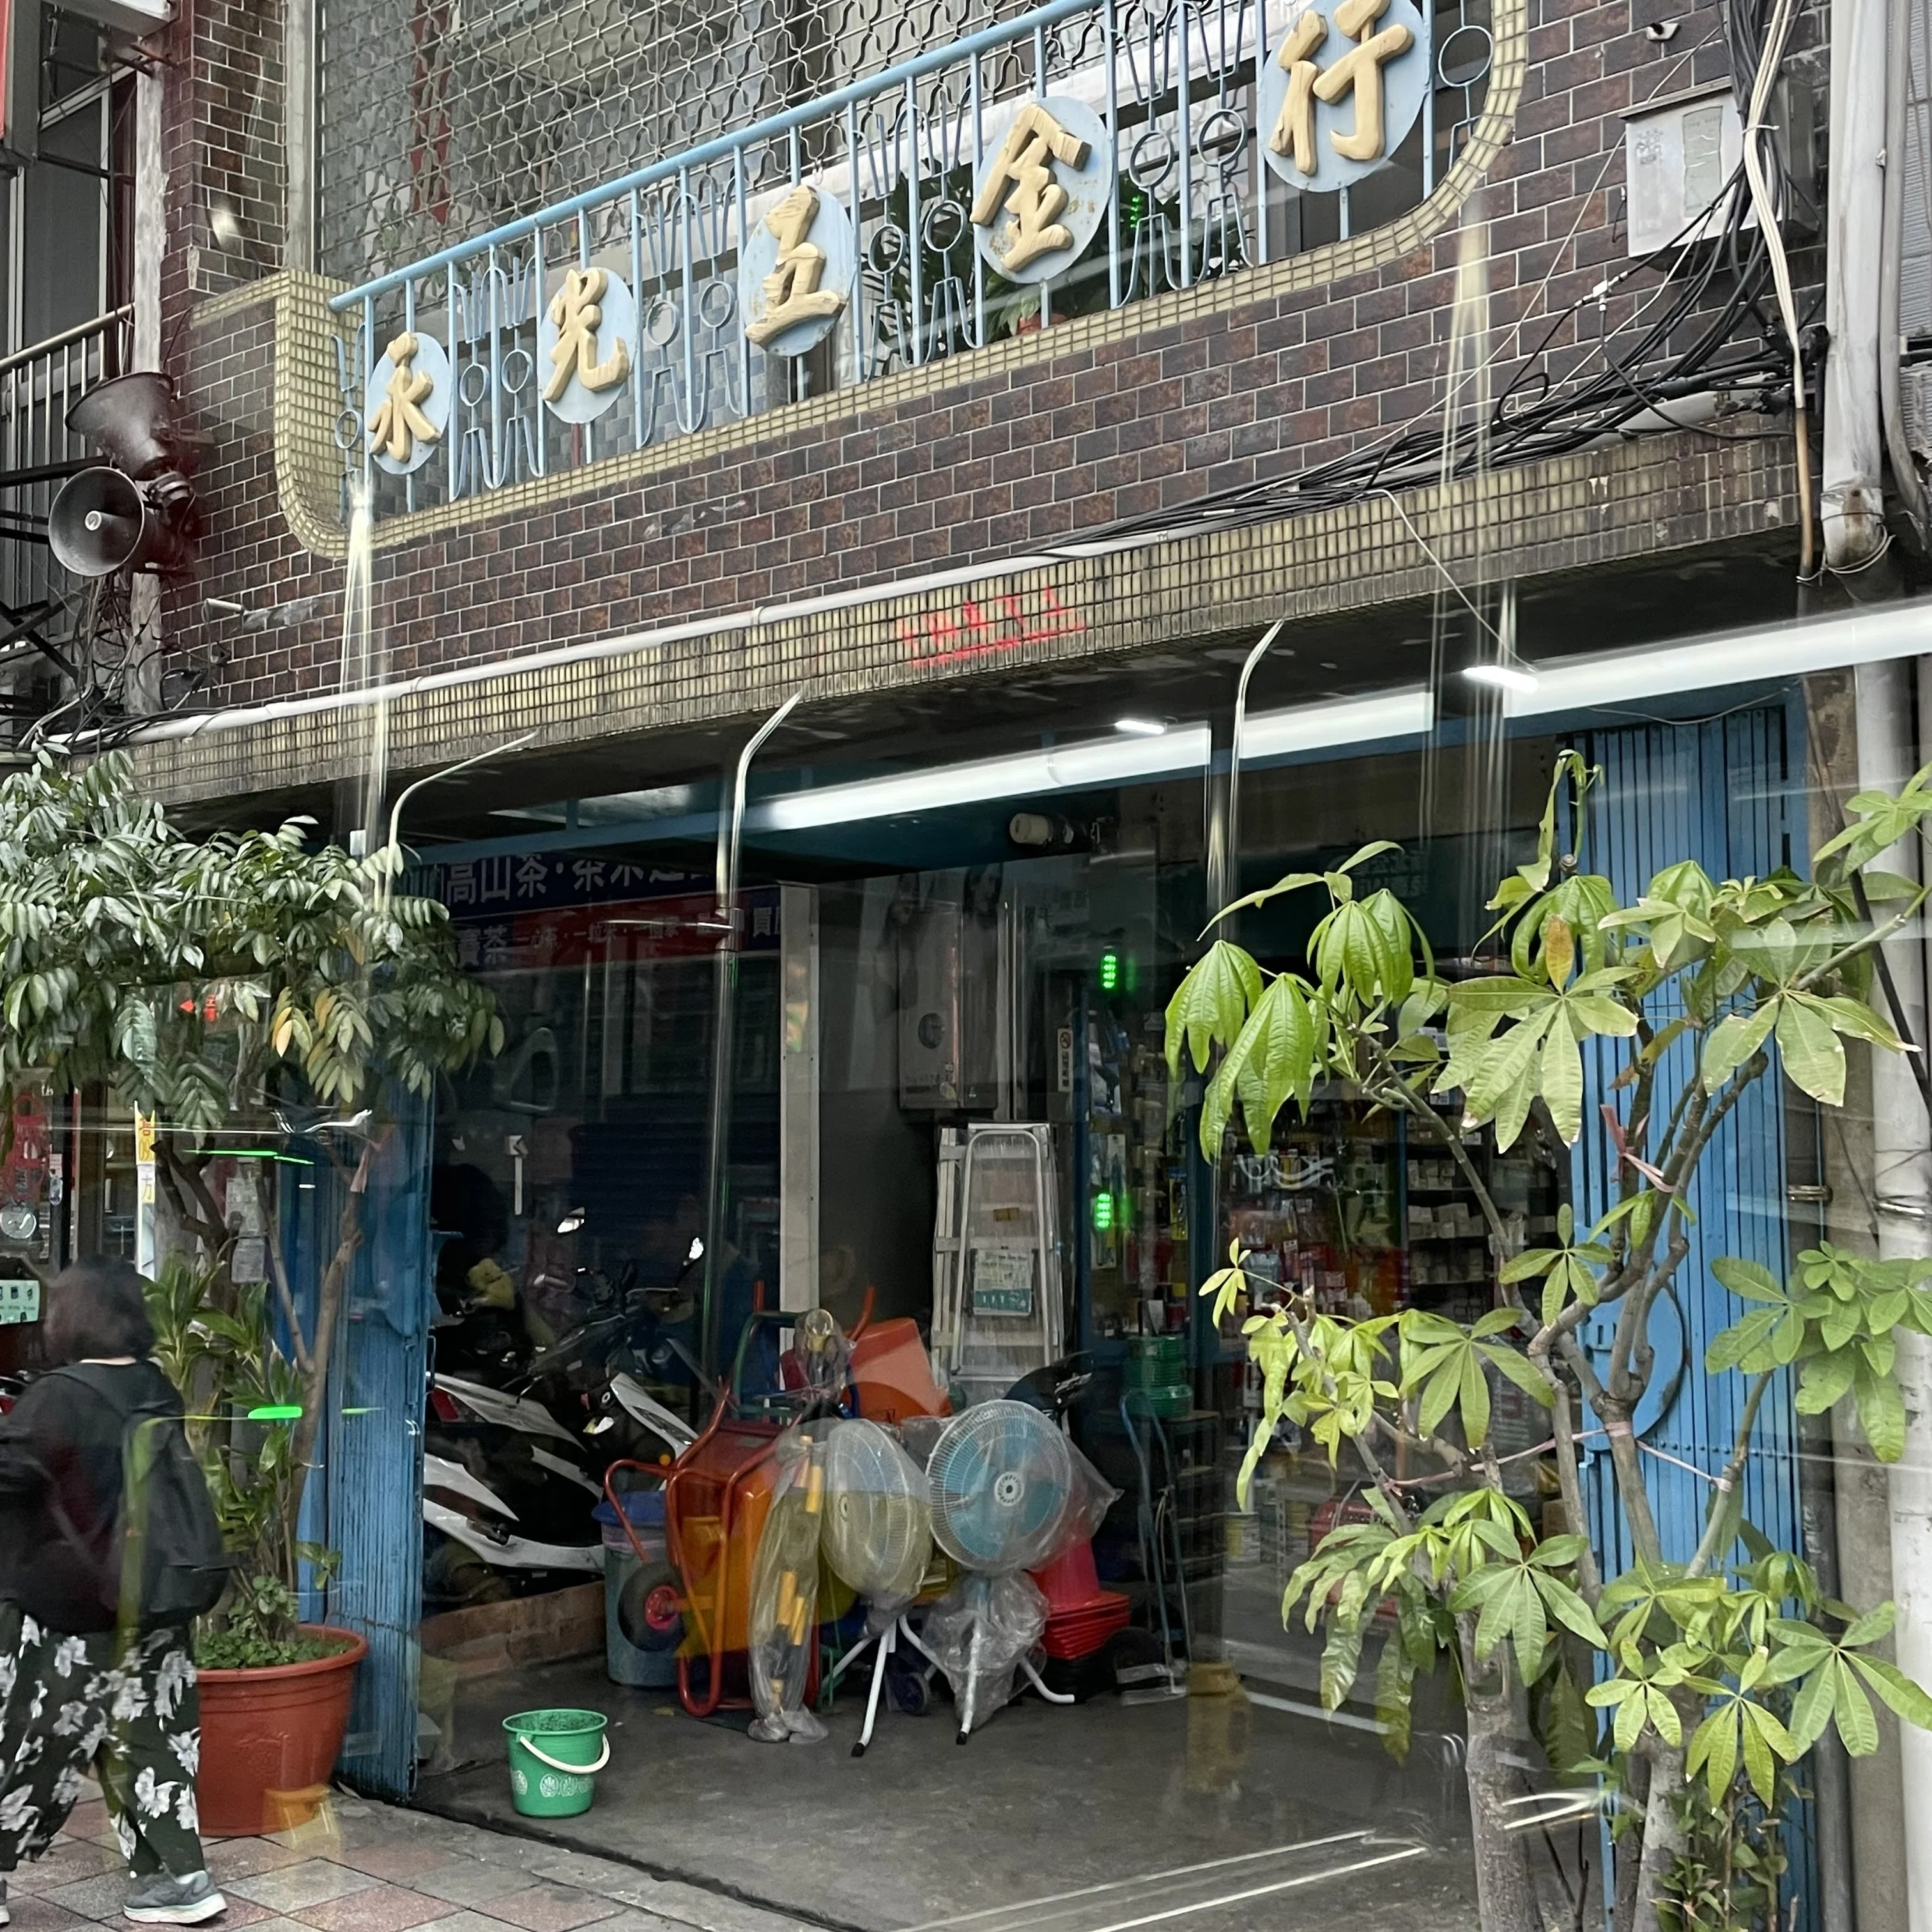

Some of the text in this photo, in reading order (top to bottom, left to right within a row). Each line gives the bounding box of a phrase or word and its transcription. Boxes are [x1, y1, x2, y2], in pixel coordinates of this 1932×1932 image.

[368, 0, 1414, 463] 永光五金行
